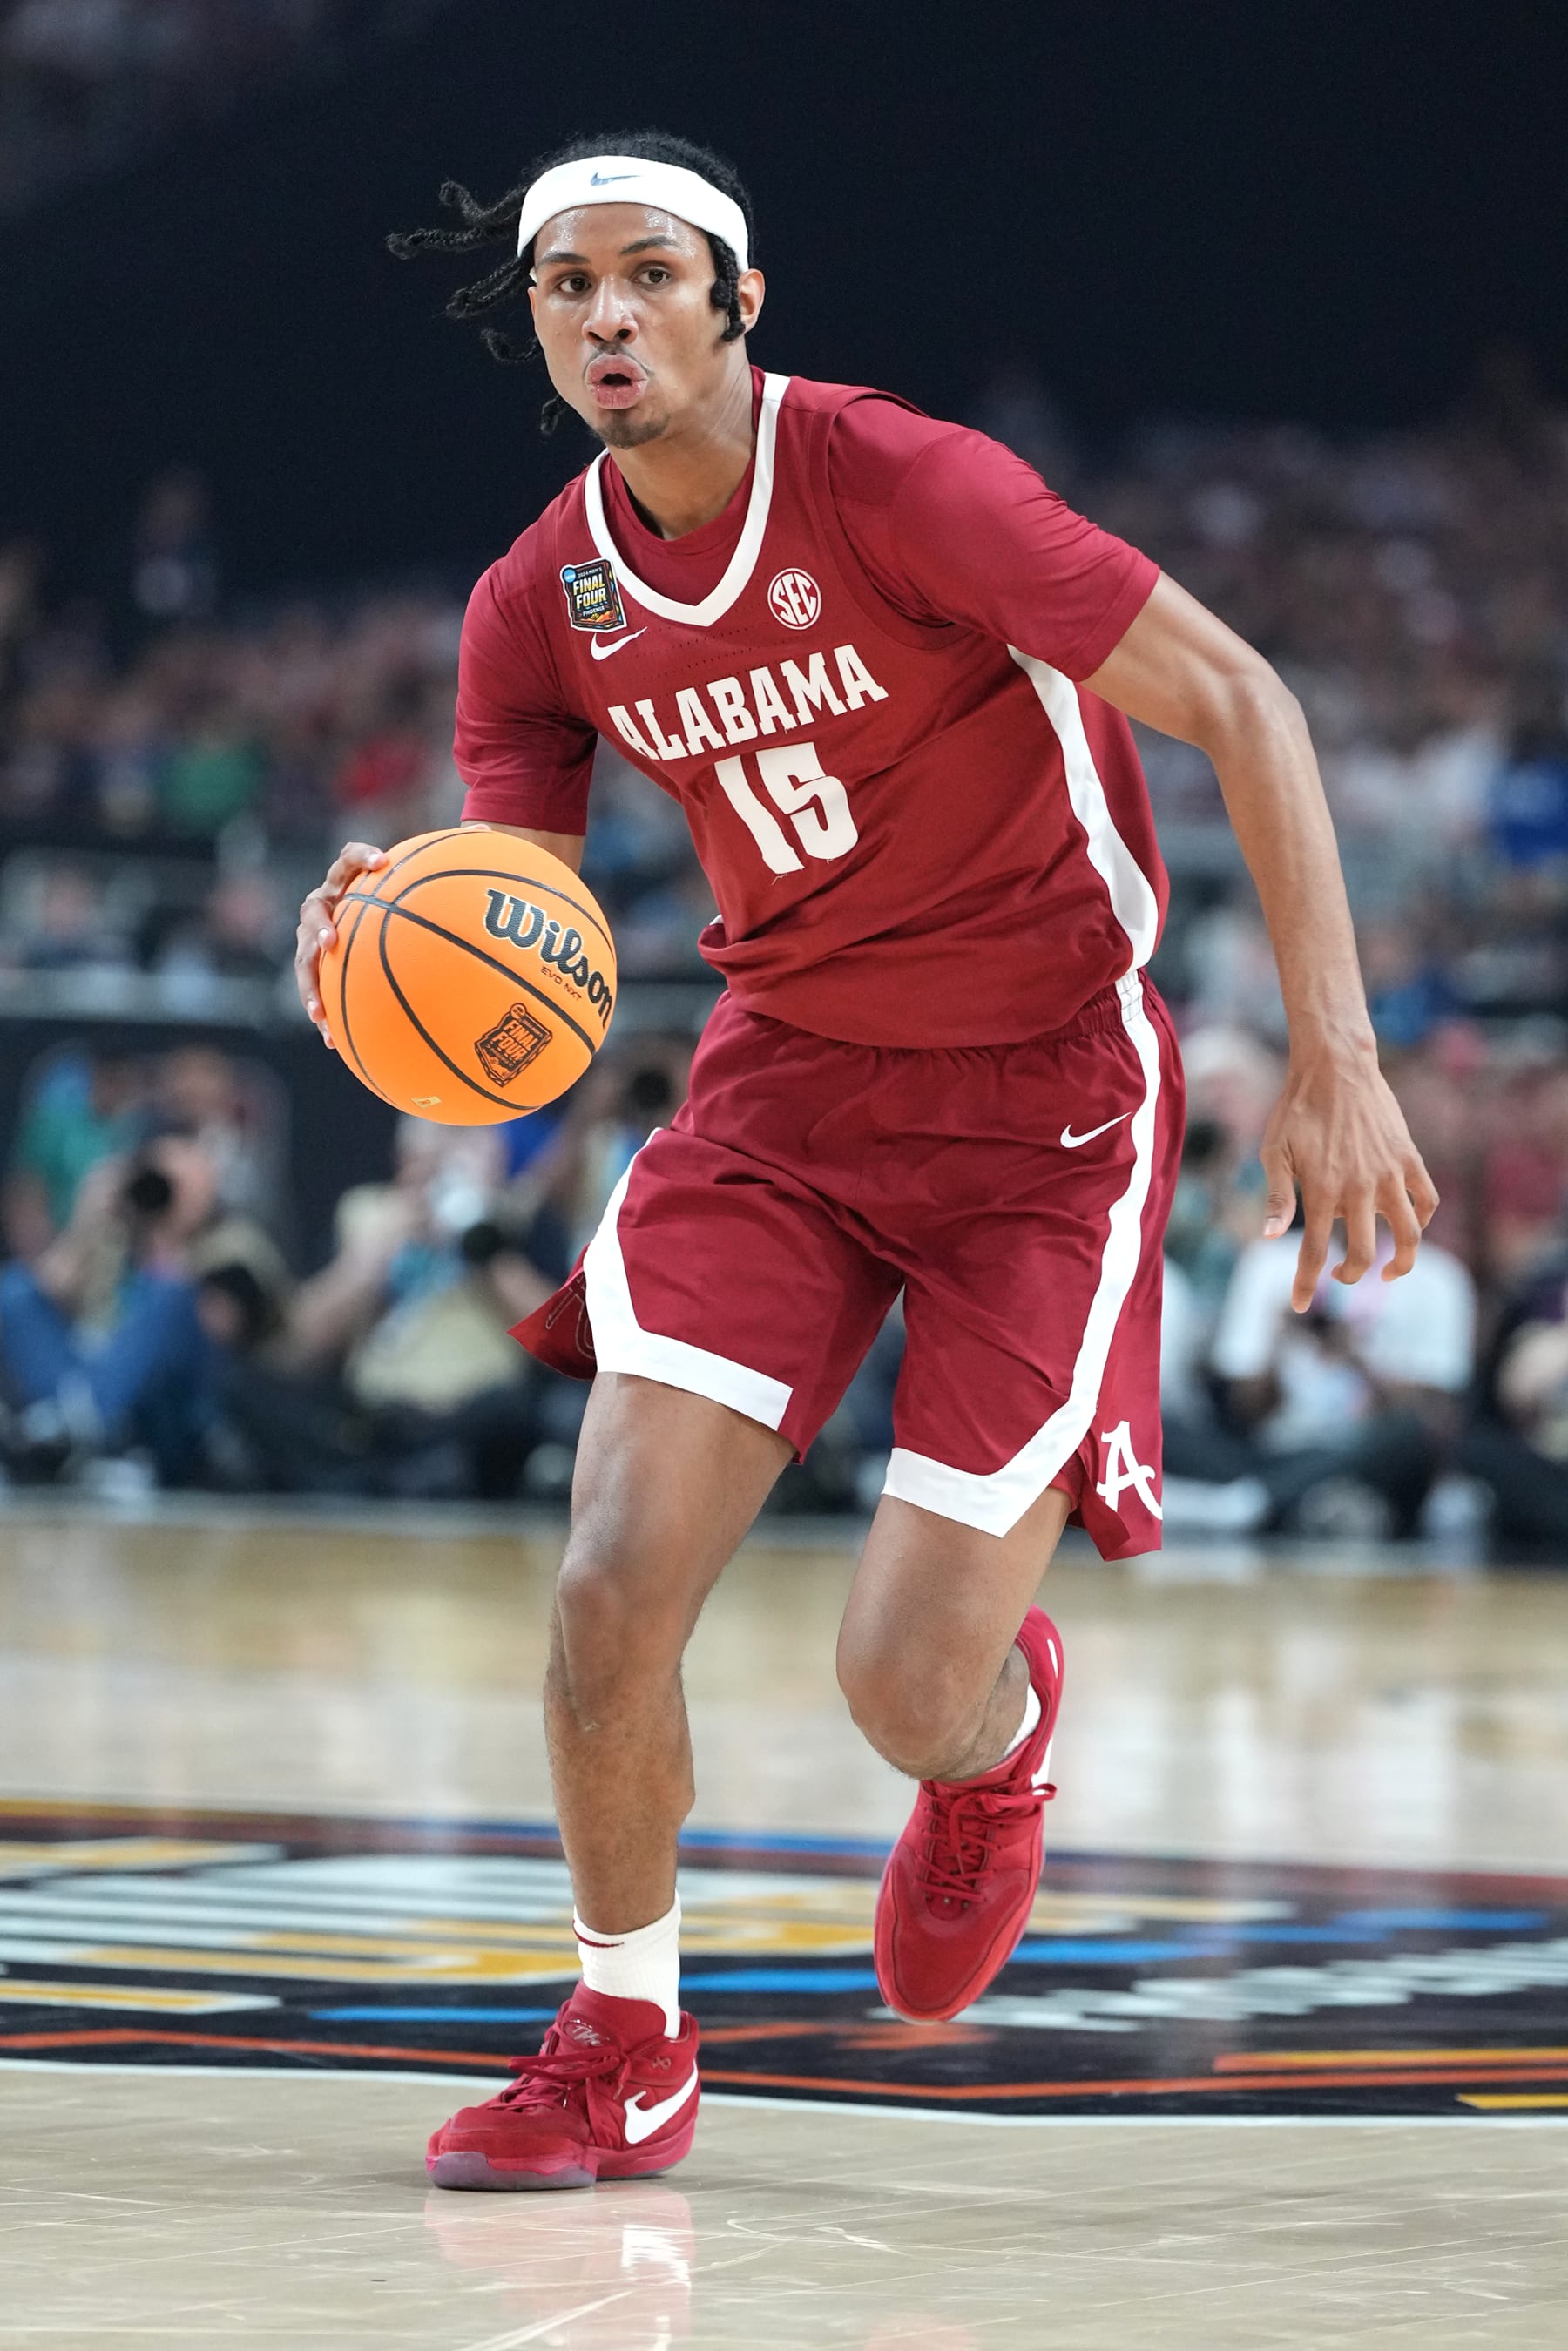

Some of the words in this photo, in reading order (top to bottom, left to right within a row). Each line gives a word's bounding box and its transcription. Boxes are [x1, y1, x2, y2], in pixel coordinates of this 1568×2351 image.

[573, 573, 605, 596] FINAL
[576, 587, 607, 610] FOUR
[772, 572, 817, 625] SEC
[583, 606, 605, 617] PHOENIX
[607, 644, 889, 761] ALABAMA
[713, 741, 859, 875] 15
[483, 888, 612, 1029] Wilson
[540, 966, 563, 985] EVO
[564, 983, 583, 1001] NXT
[490, 1030, 529, 1061] FOUR
[503, 1019, 538, 1051] FINAL
[1096, 1420, 1163, 1521] A
